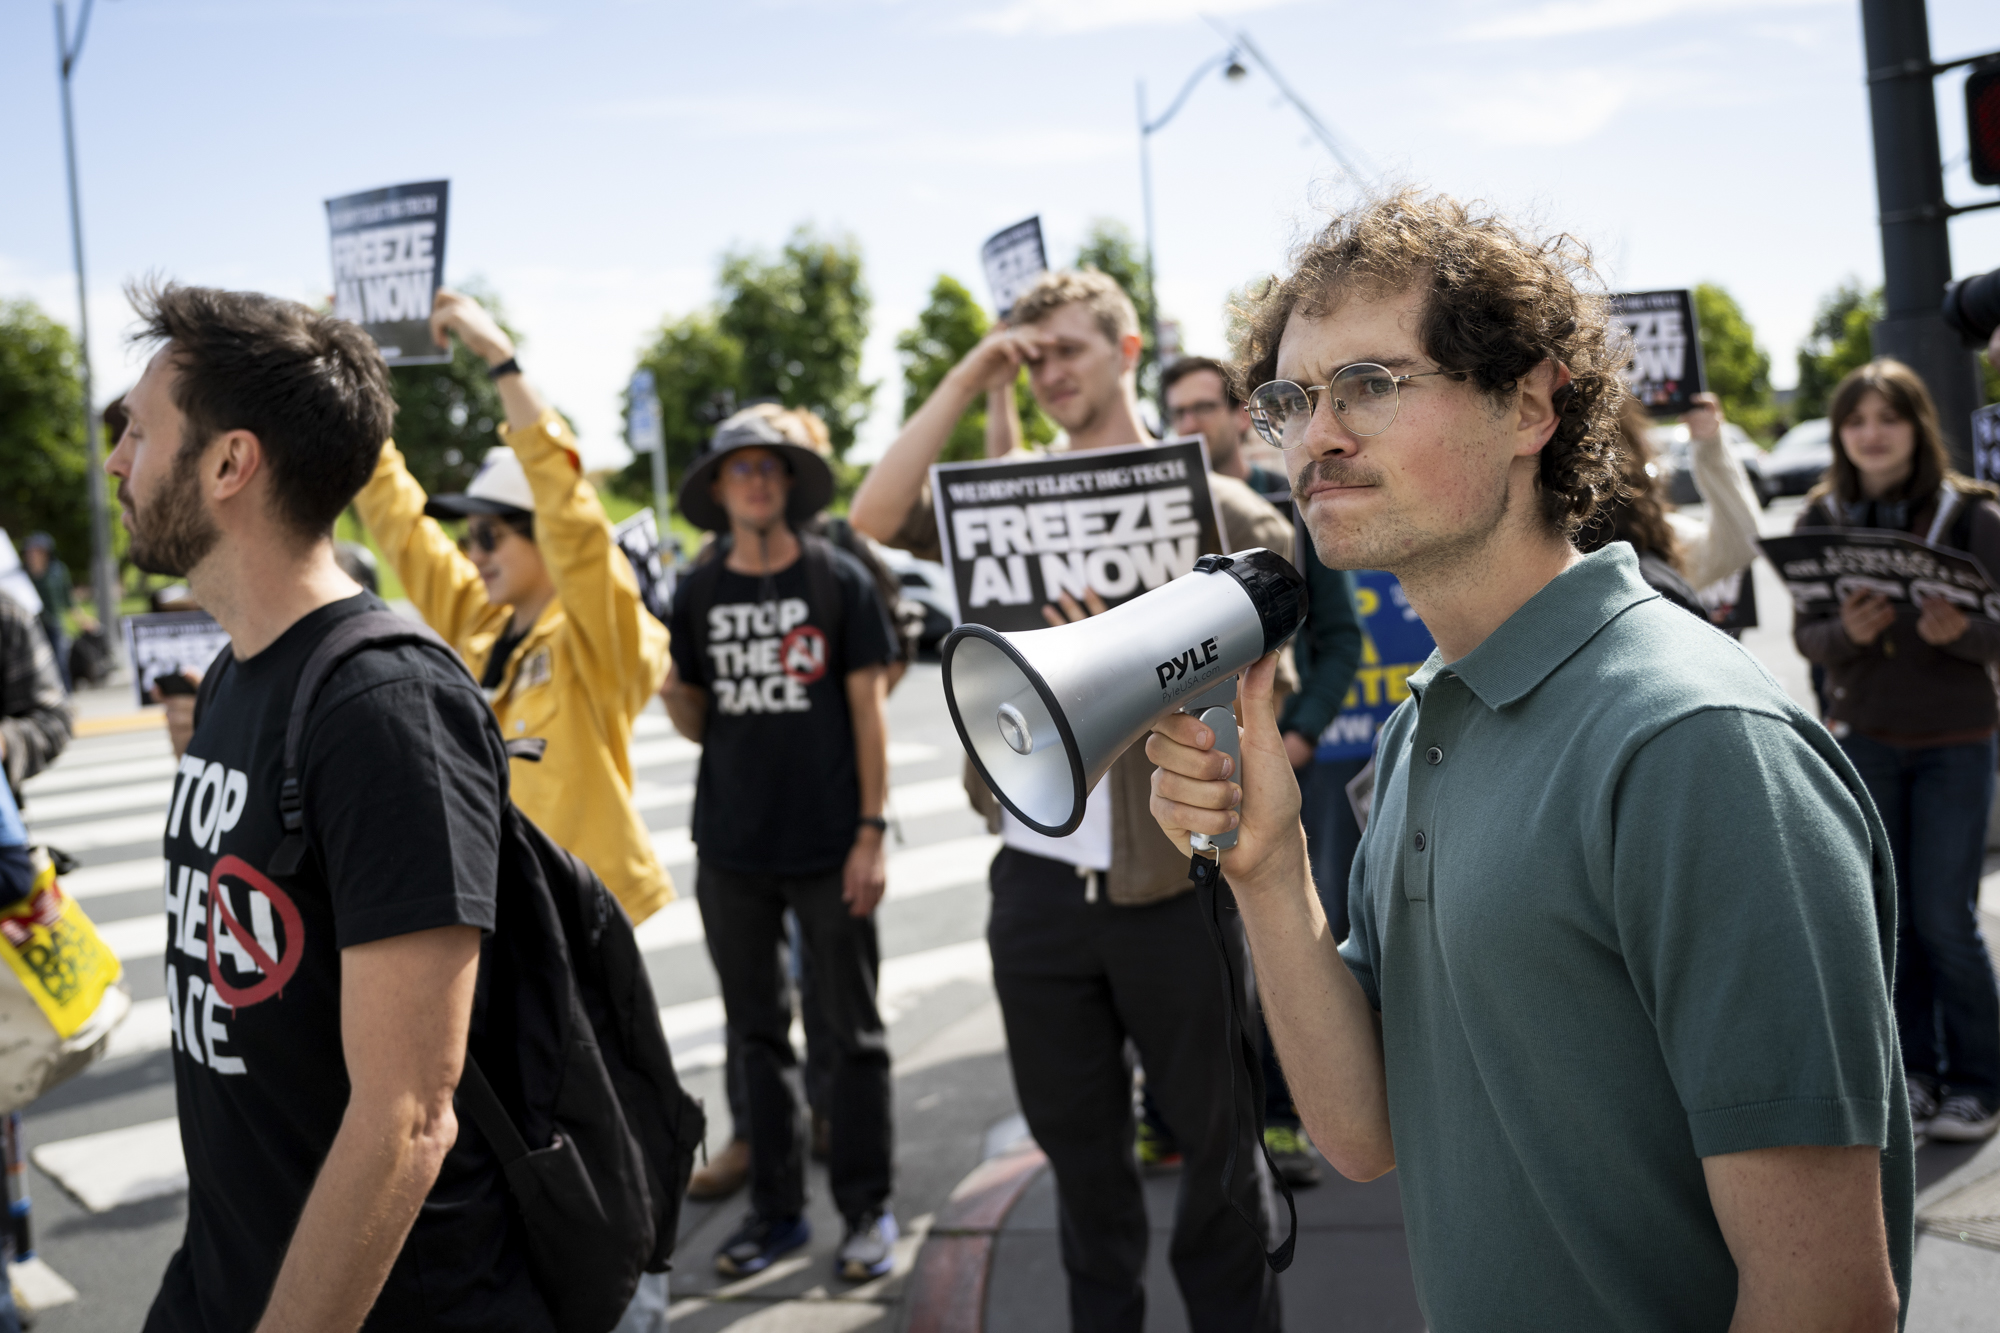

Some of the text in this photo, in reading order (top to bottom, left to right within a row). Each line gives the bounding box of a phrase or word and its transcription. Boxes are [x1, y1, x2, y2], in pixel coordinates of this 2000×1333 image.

[1130, 458, 1188, 486] TECH
[951, 486, 1200, 561] FREEZE
[968, 534, 1199, 608] AI NOW
[707, 597, 809, 642] STOP
[706, 637, 783, 679] THE
[1162, 665, 1220, 703] PyleUSA.com
[168, 752, 249, 855] TOP
[164, 857, 209, 962] HE
[167, 962, 249, 1075] ACE
